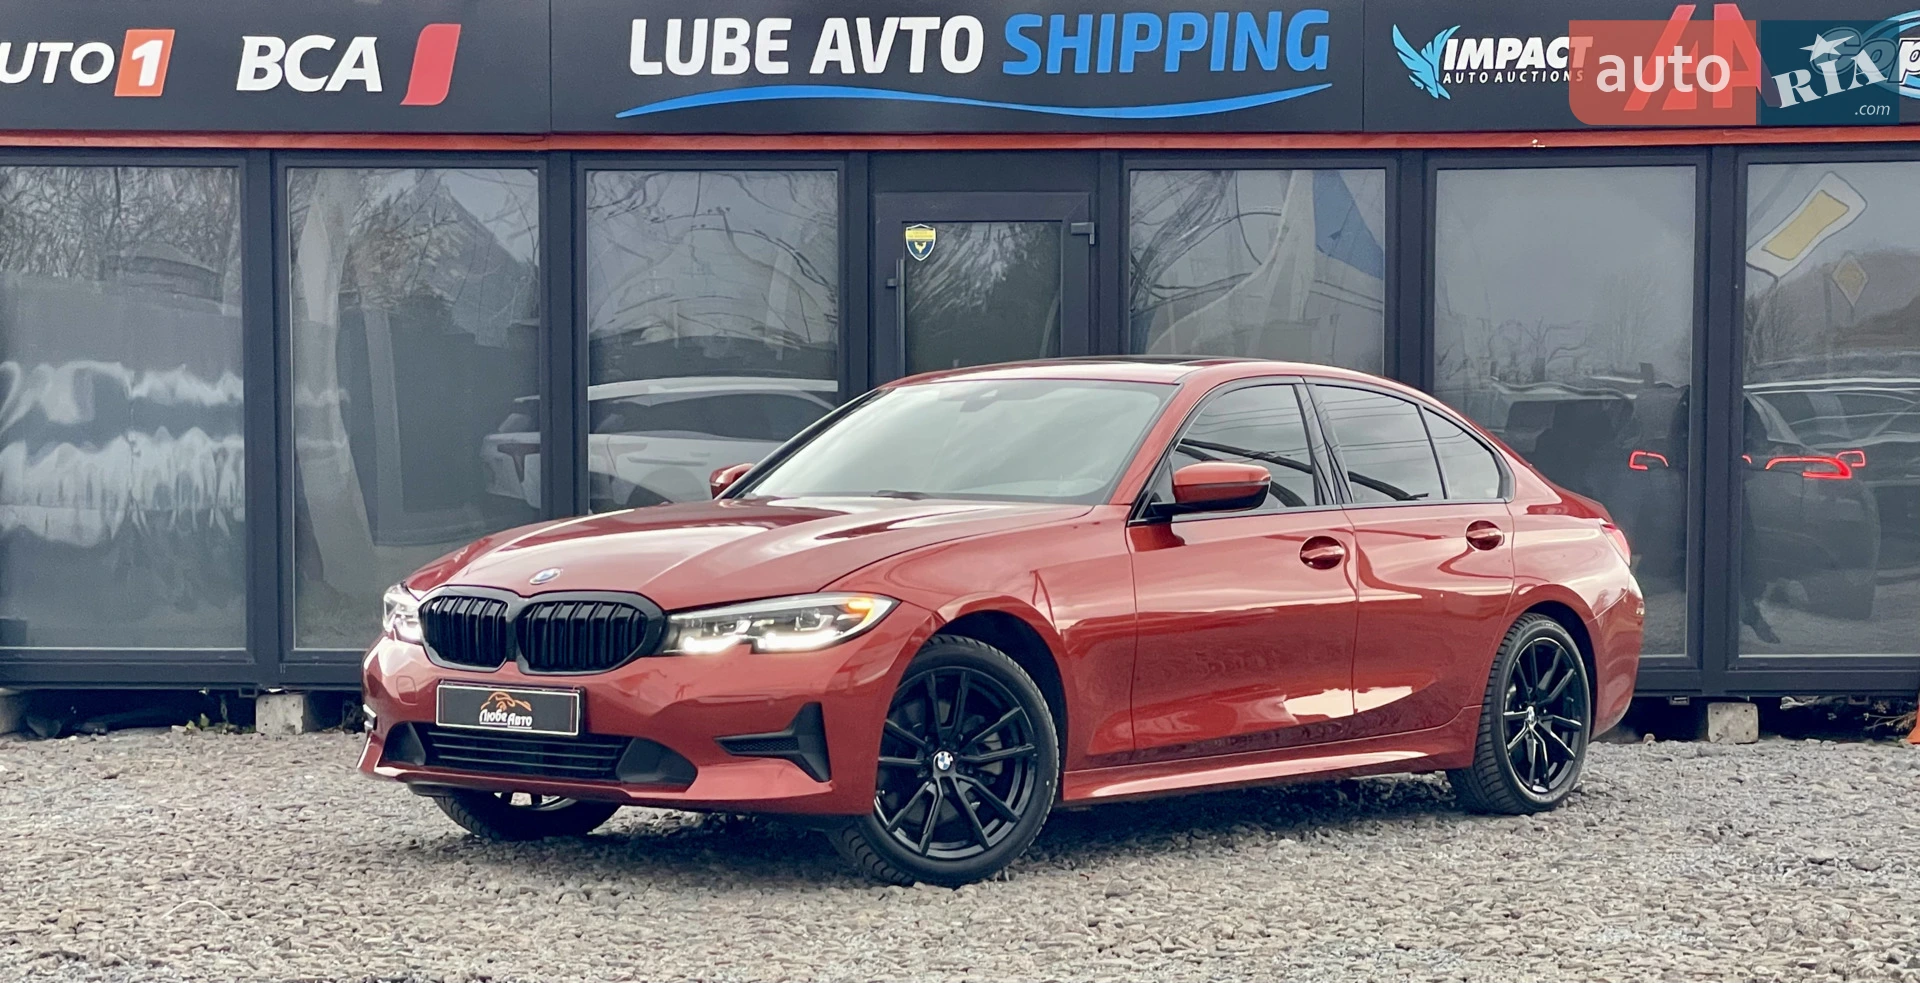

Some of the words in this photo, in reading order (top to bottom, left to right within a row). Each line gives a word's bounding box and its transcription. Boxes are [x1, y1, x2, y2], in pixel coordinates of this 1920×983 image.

[236, 34, 383, 92] BCA
[630, 17, 793, 75] LUBE
[809, 15, 985, 74] AVTO
[1002, 9, 1330, 75] SHIPPING
[1443, 36, 1594, 71] IMPACT
[1442, 71, 1489, 84] AUTO
[1494, 70, 1584, 83] AUCTIONS
